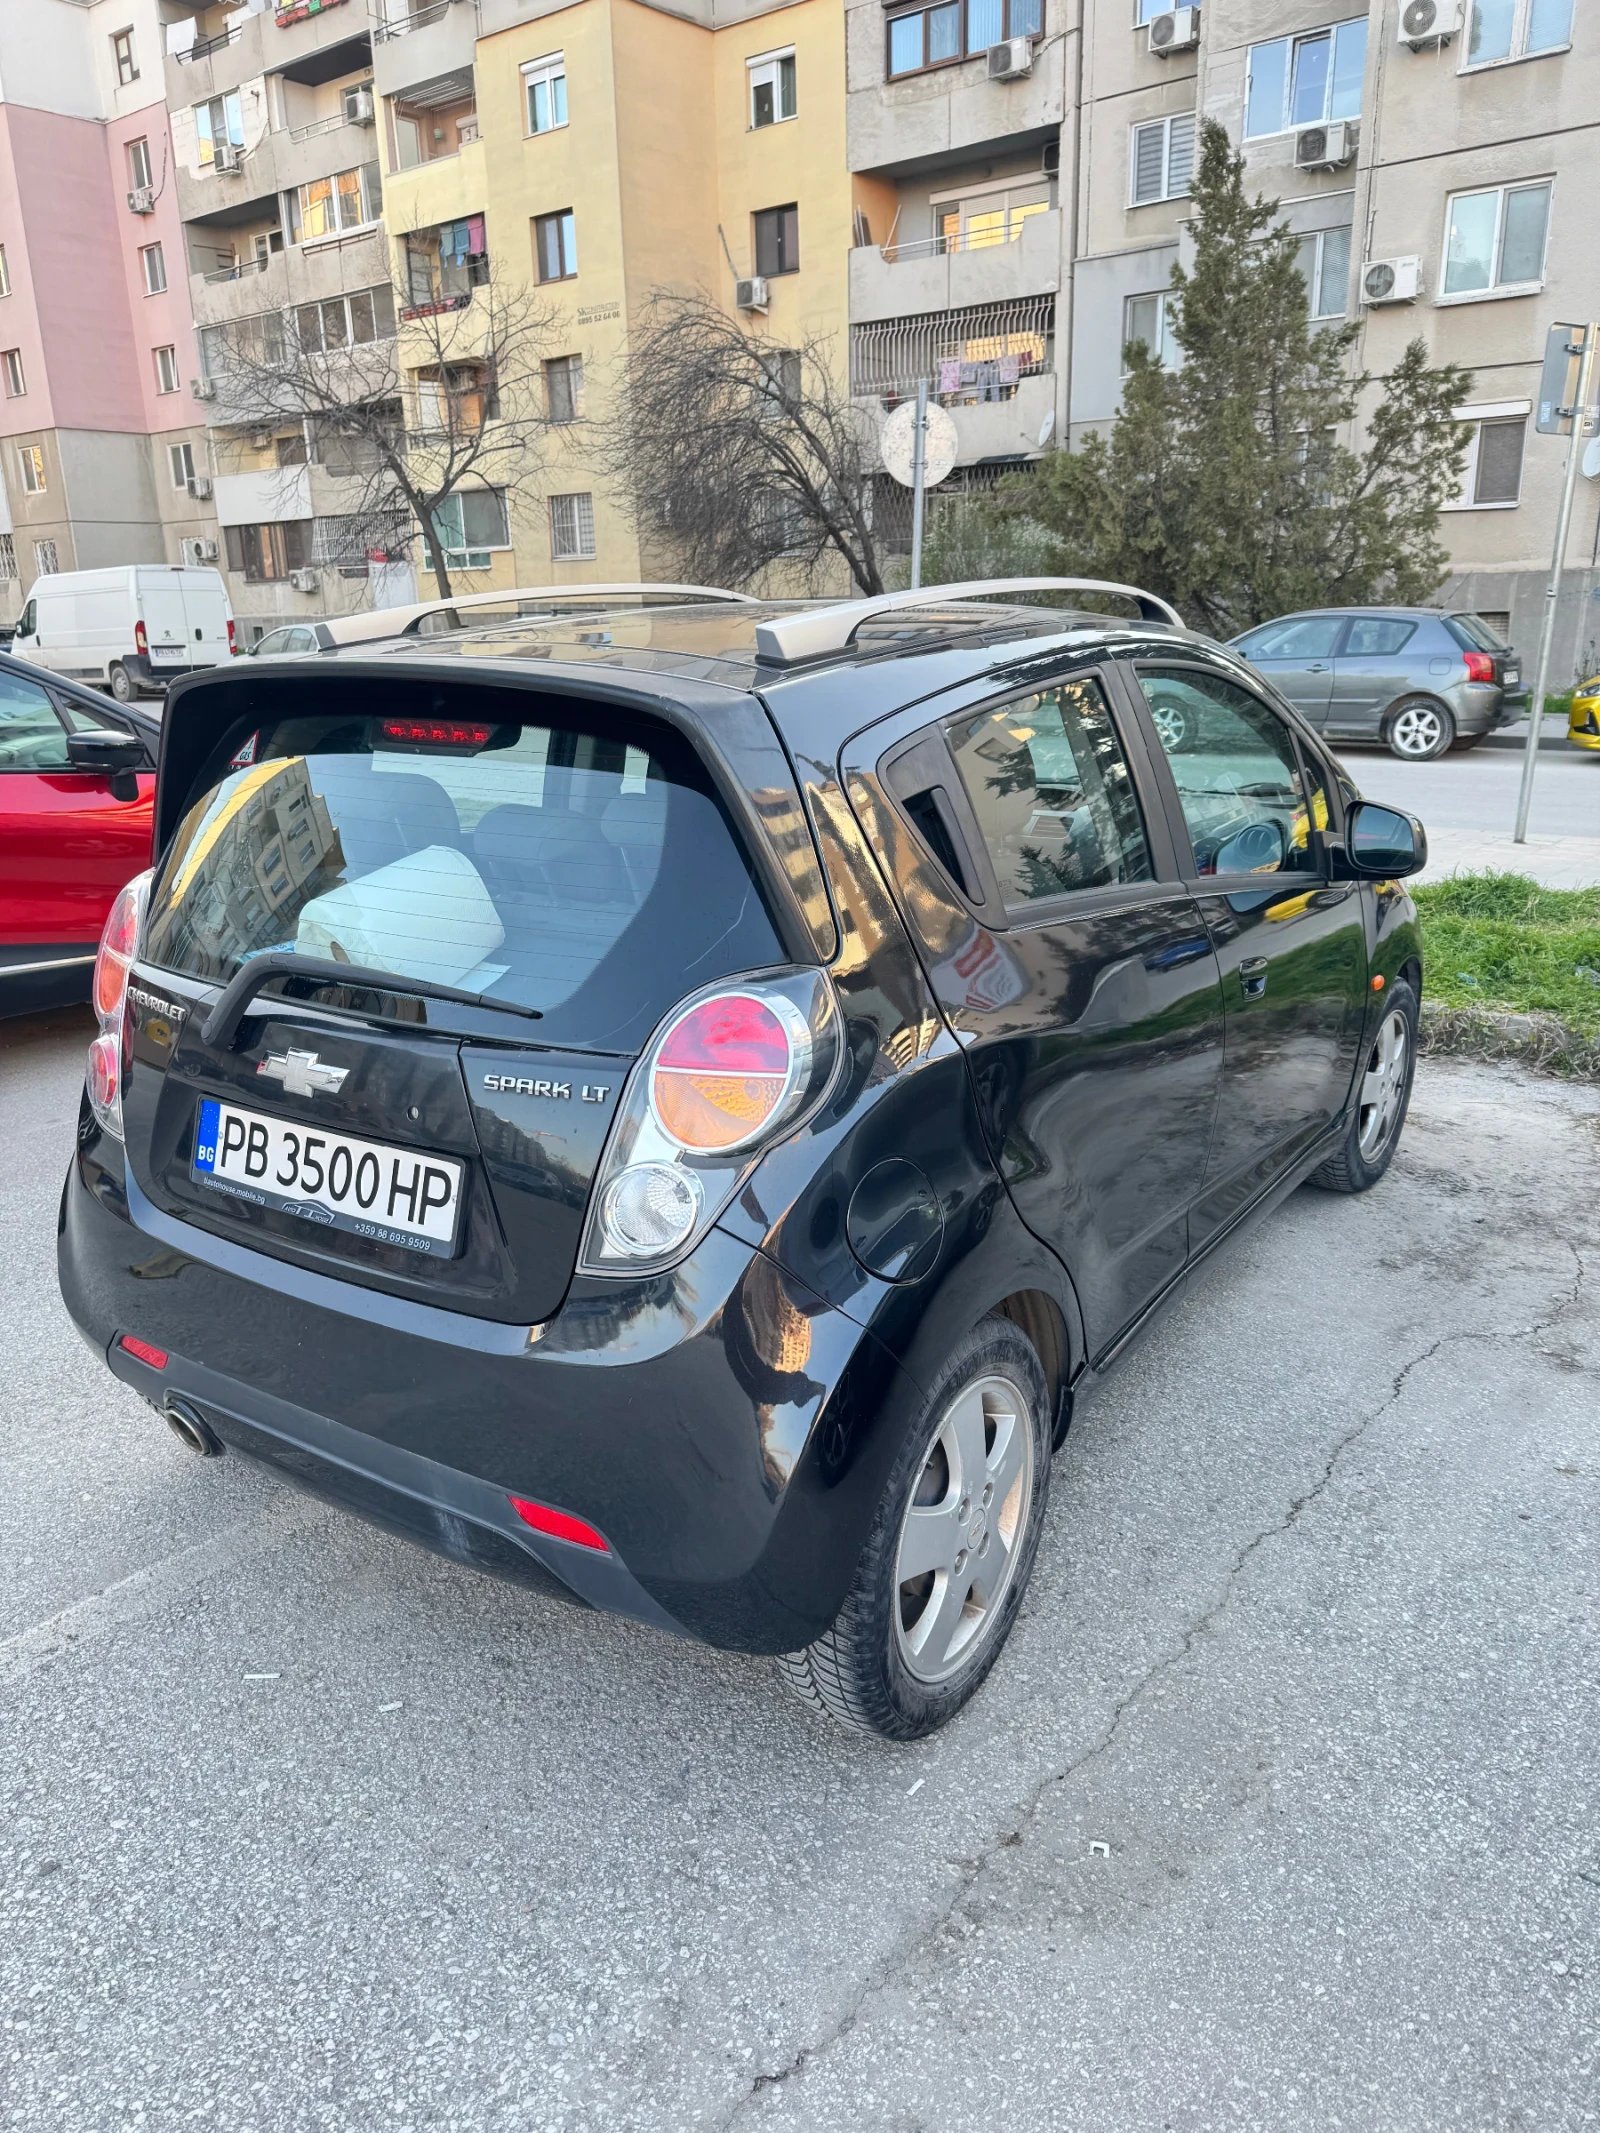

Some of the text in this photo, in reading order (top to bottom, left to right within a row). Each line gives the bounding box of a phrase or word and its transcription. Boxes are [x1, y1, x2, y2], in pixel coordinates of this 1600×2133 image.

[128, 986, 186, 1022] CHEVROLET
[483, 1074, 610, 1102] SPARK LT
[198, 1145, 214, 1162] BG
[221, 1115, 452, 1225] PB 3500 HP
[354, 1223, 431, 1251] +359 88 695 9509
